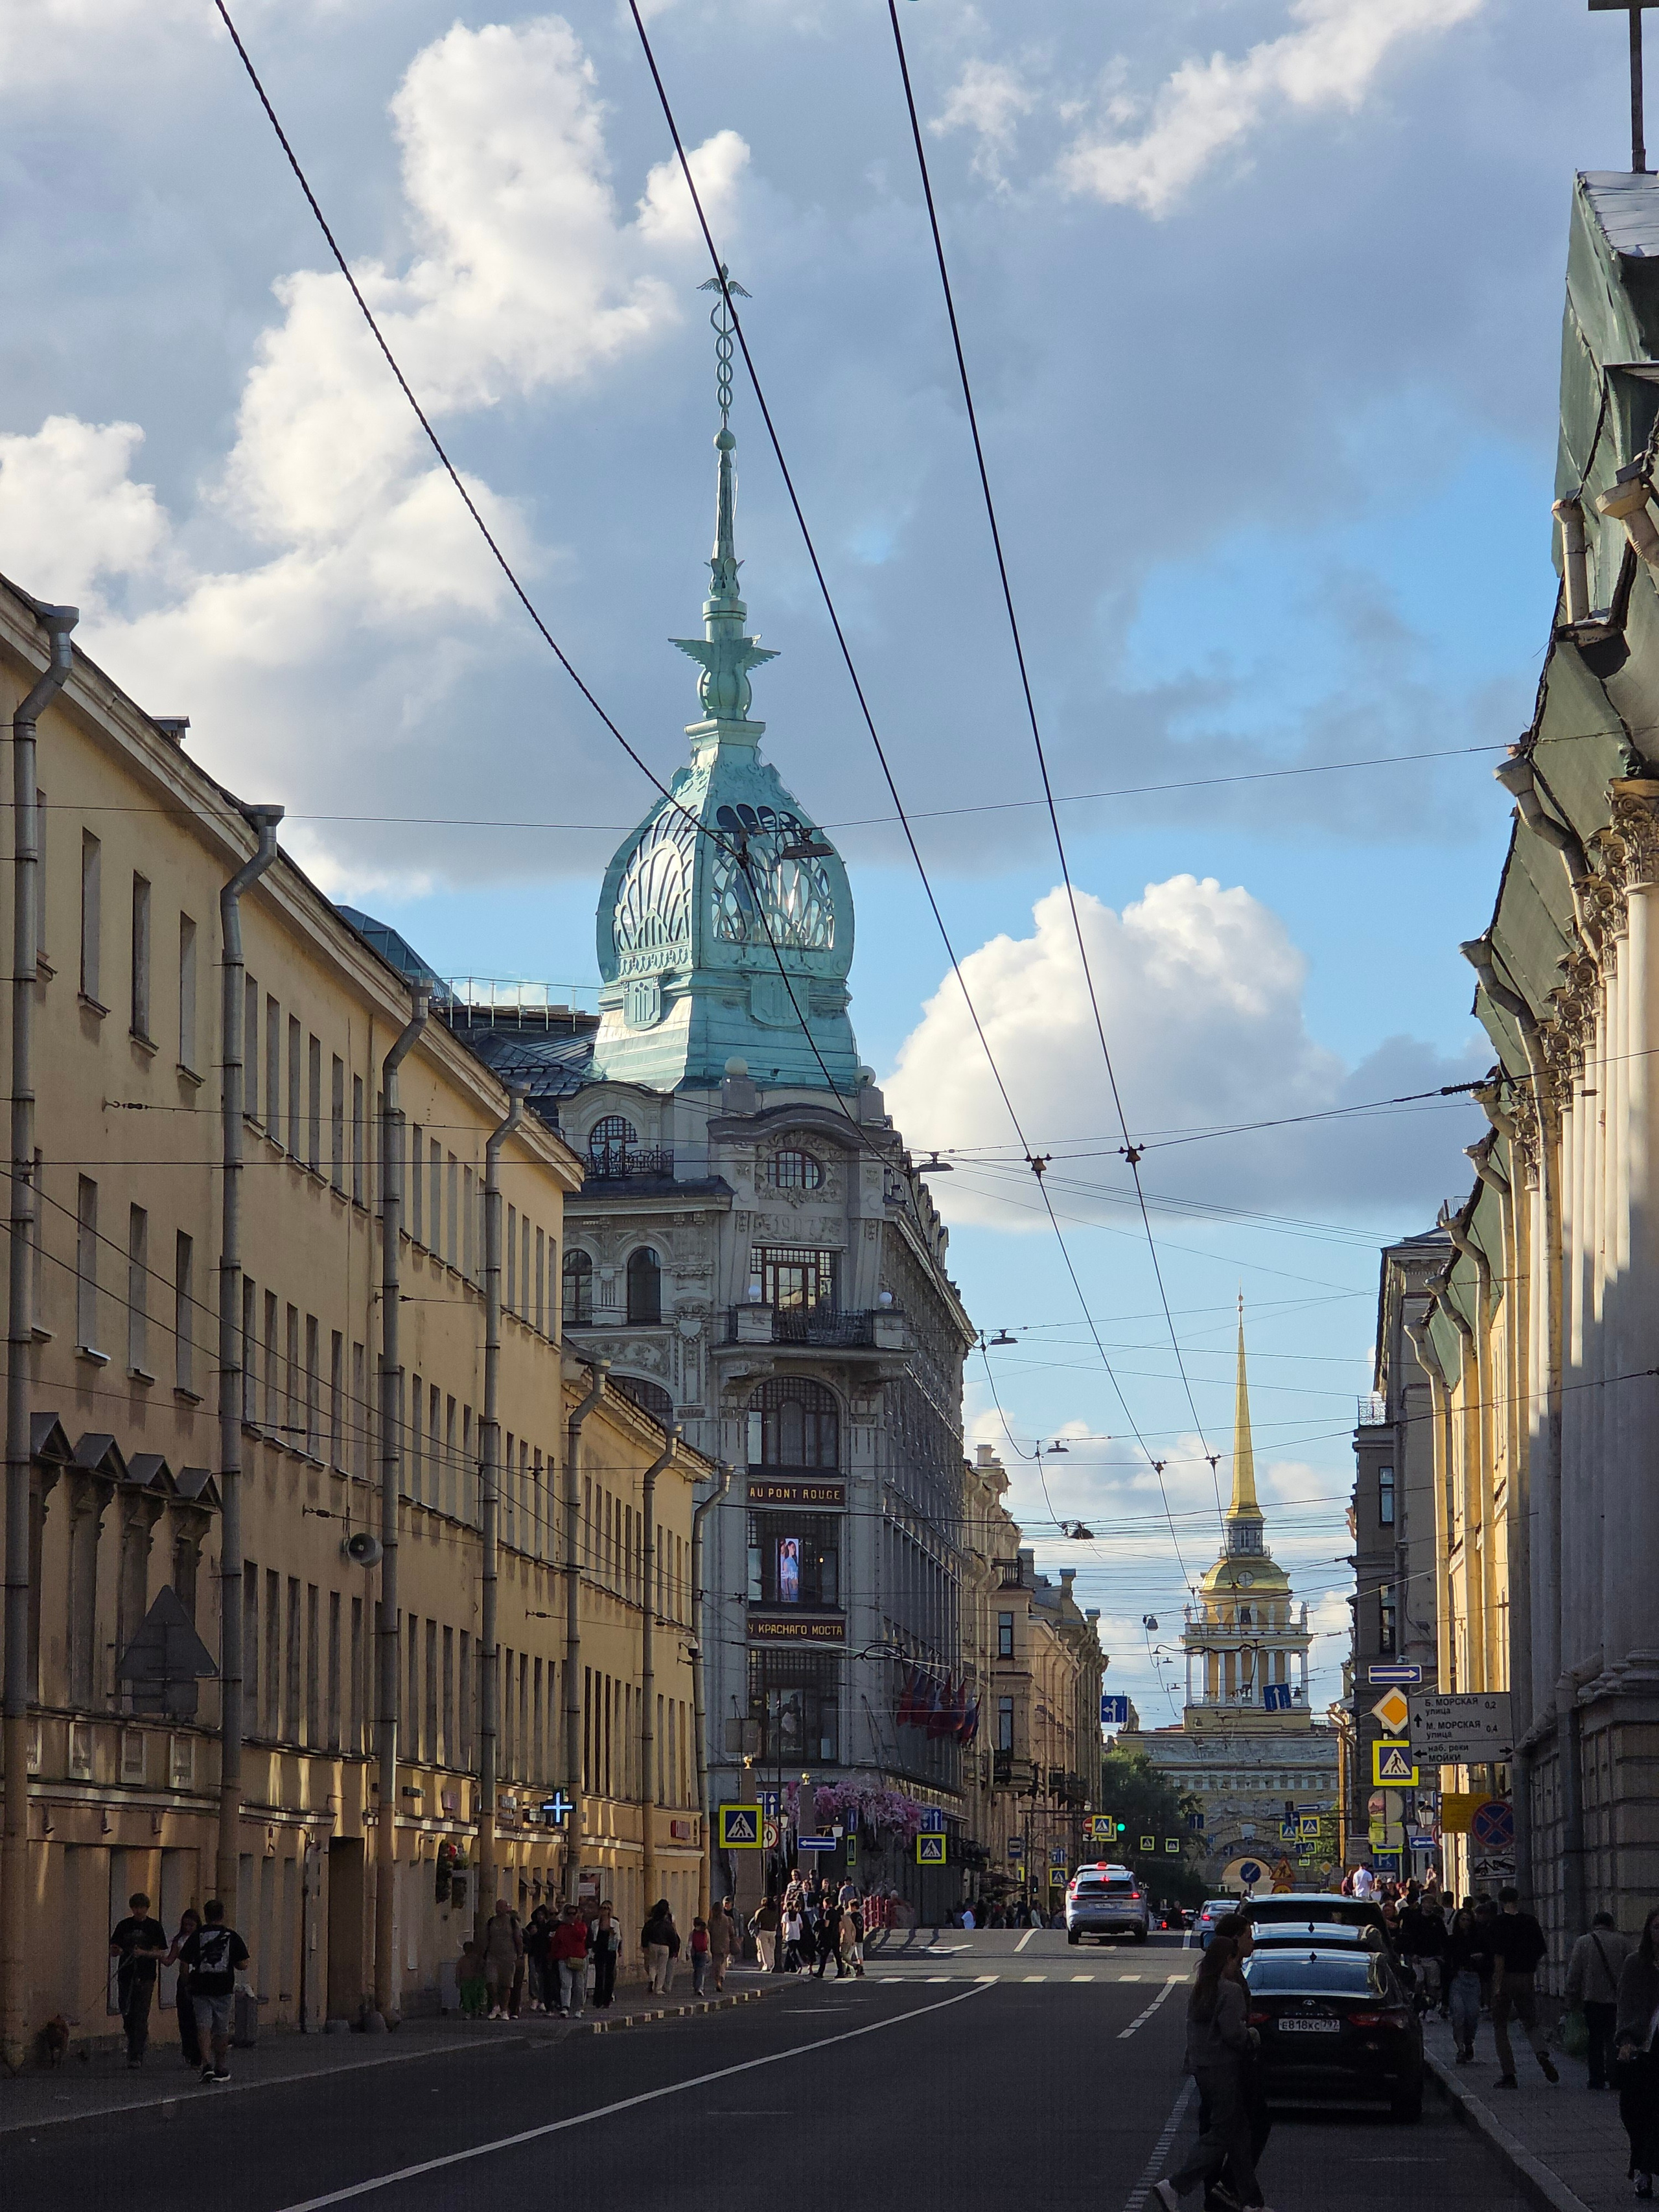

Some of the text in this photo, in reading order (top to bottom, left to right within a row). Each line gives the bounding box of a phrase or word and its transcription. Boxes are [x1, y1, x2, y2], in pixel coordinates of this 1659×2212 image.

[774, 1216, 815, 1236] 1907
[750, 1487, 841, 1500] AU PONT ROUGE
[748, 1624, 842, 1635] У КРАСНАГО МОСТА
[1435, 1697, 1478, 1706] МОРСКАЯ
[1426, 1708, 1451, 1716] улица
[1426, 1732, 1452, 1740] улица
[1428, 1743, 1468, 1753] наб. реки
[1428, 1753, 1461, 1762] МОЙКИ
